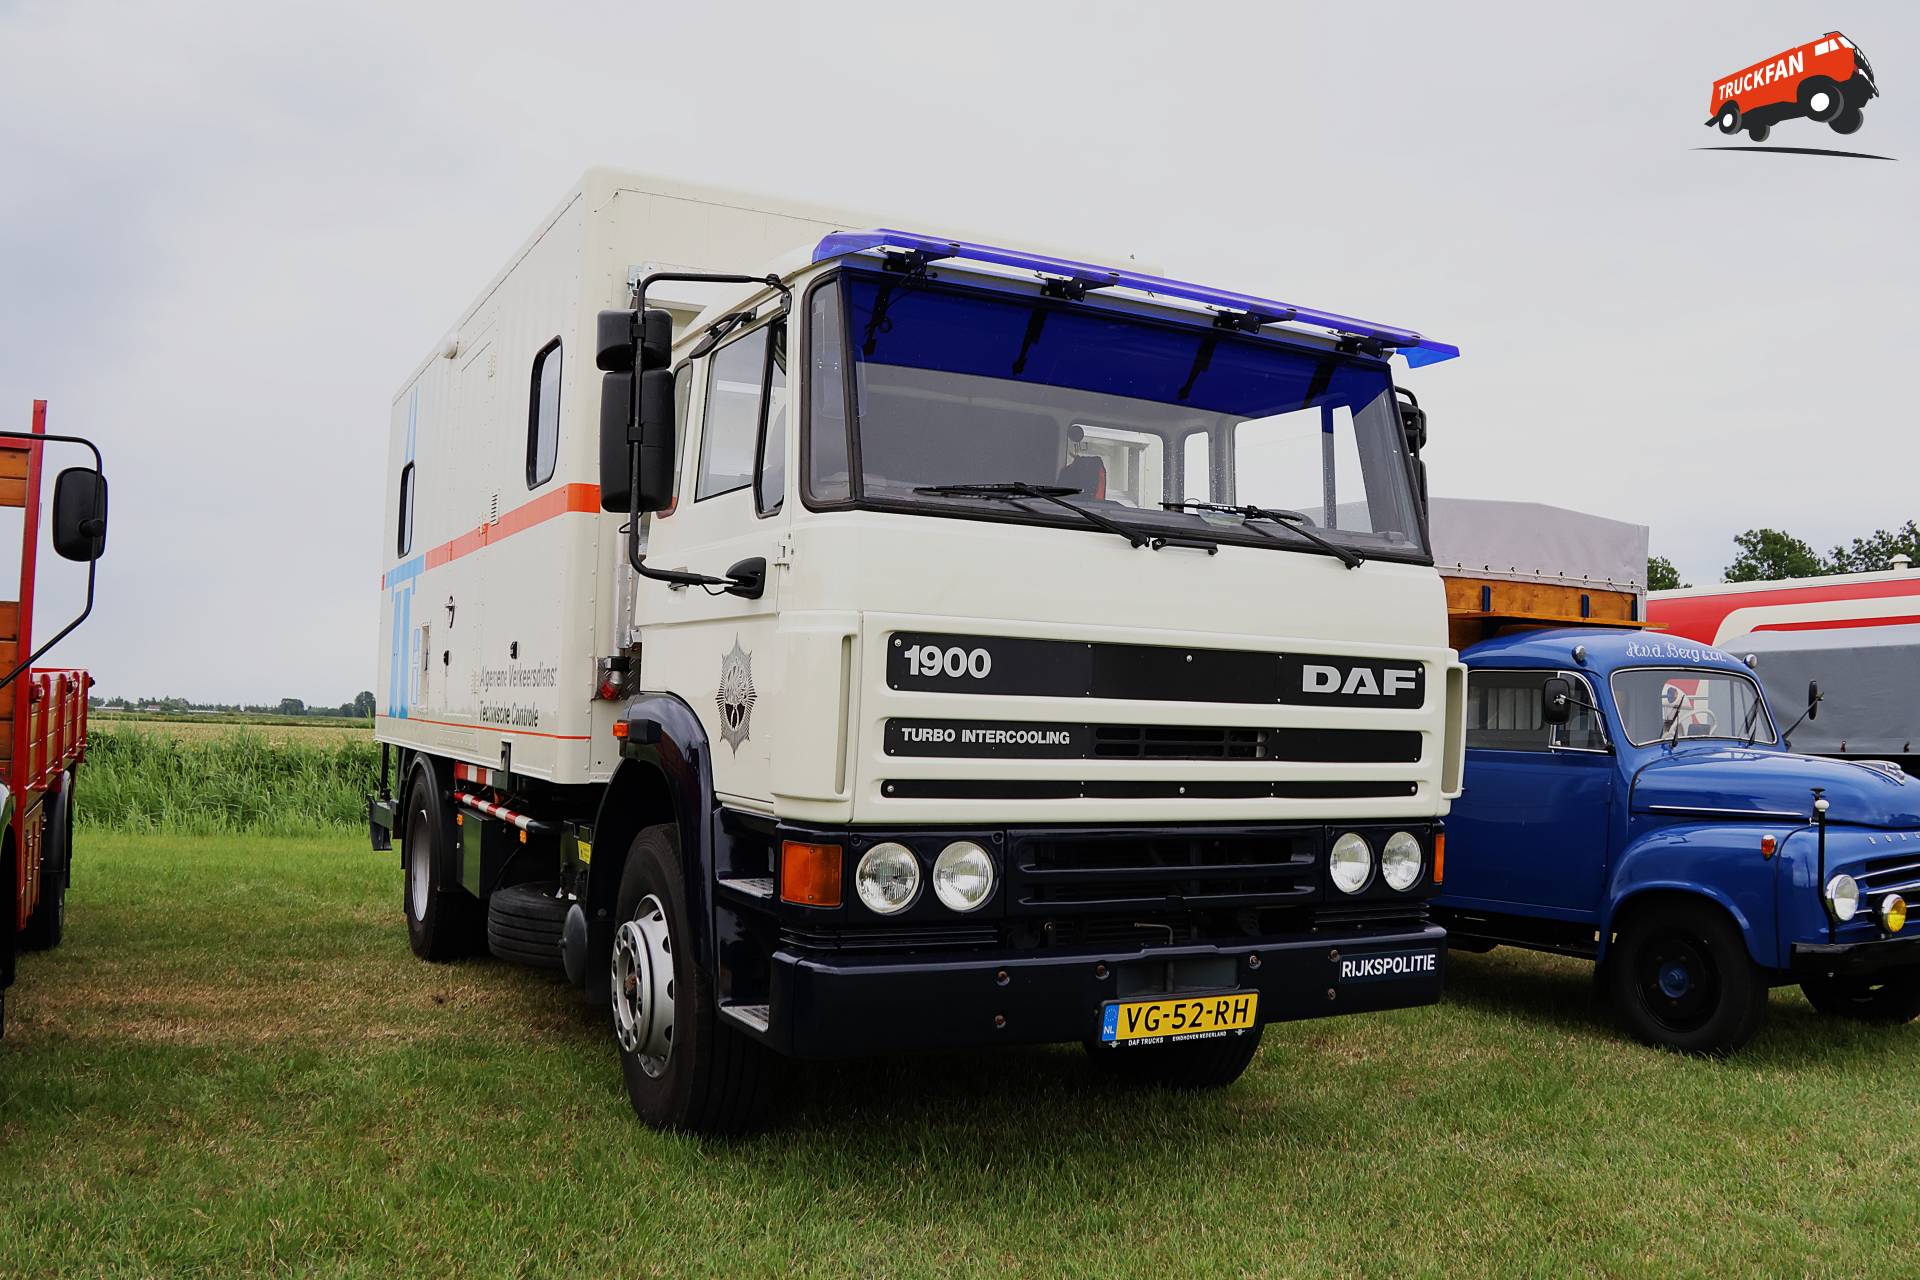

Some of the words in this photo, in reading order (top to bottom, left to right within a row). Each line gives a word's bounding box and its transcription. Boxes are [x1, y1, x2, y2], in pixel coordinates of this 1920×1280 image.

[904, 644, 992, 679] 1900
[1302, 664, 1416, 696] DAF
[512, 701, 539, 728] Controle
[901, 727, 956, 742] TURBO
[961, 729, 1070, 744] INTERCOOLING
[1341, 954, 1436, 978] RIJKSPOLITIE
[1126, 998, 1250, 1033] VG-52-RH
[1103, 1025, 1115, 1035] NL
[1128, 1038, 1140, 1047] DAF
[1141, 1037, 1164, 1045] TRUCKS
